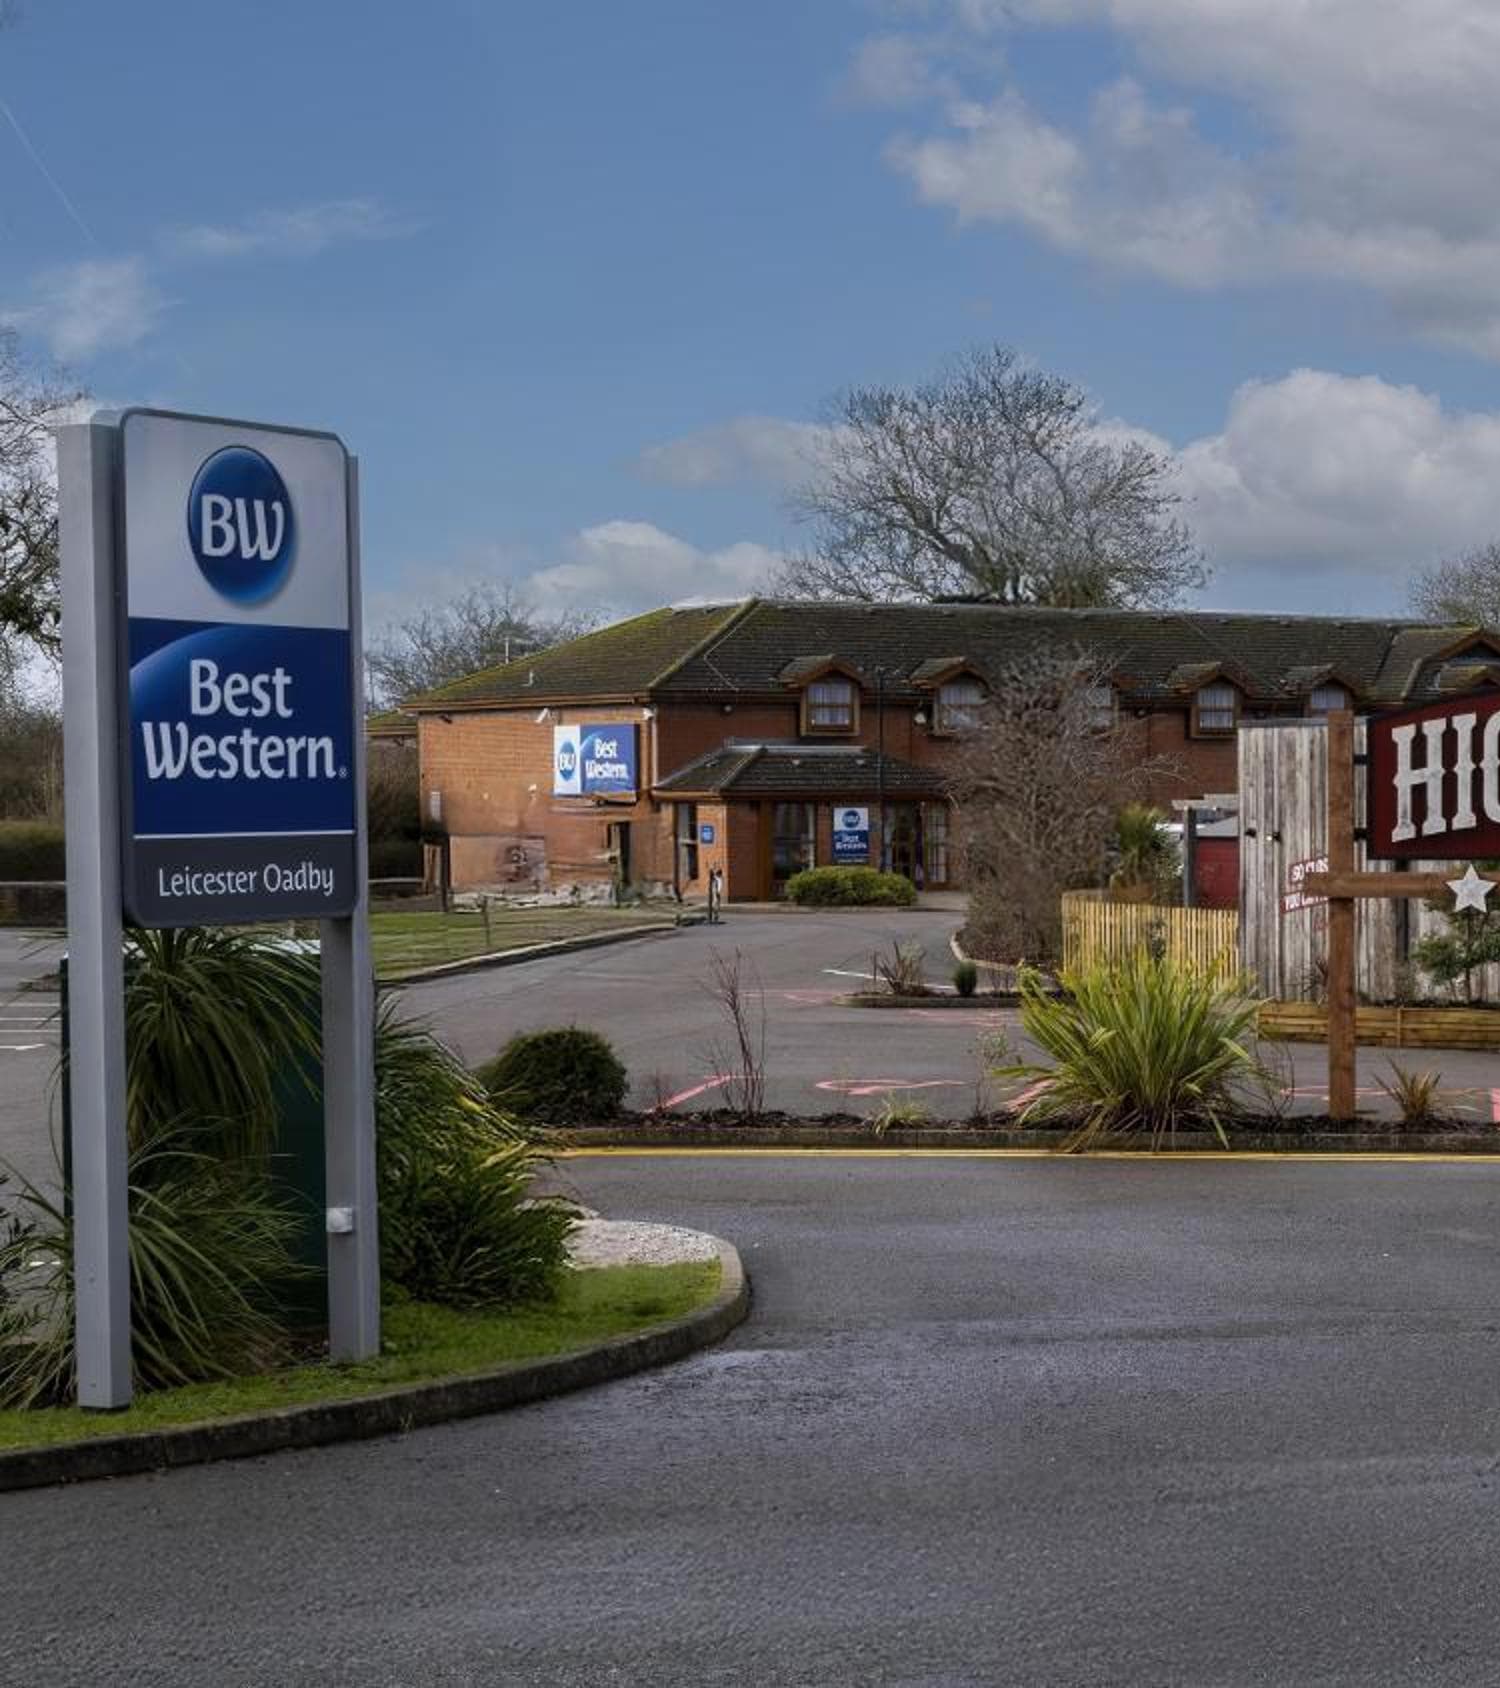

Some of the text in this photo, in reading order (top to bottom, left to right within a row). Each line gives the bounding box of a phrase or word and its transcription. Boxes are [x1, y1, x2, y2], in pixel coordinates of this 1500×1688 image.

[201, 494, 285, 561] BW
[190, 658, 294, 719] Best
[158, 862, 335, 897] Leicester Oadby
